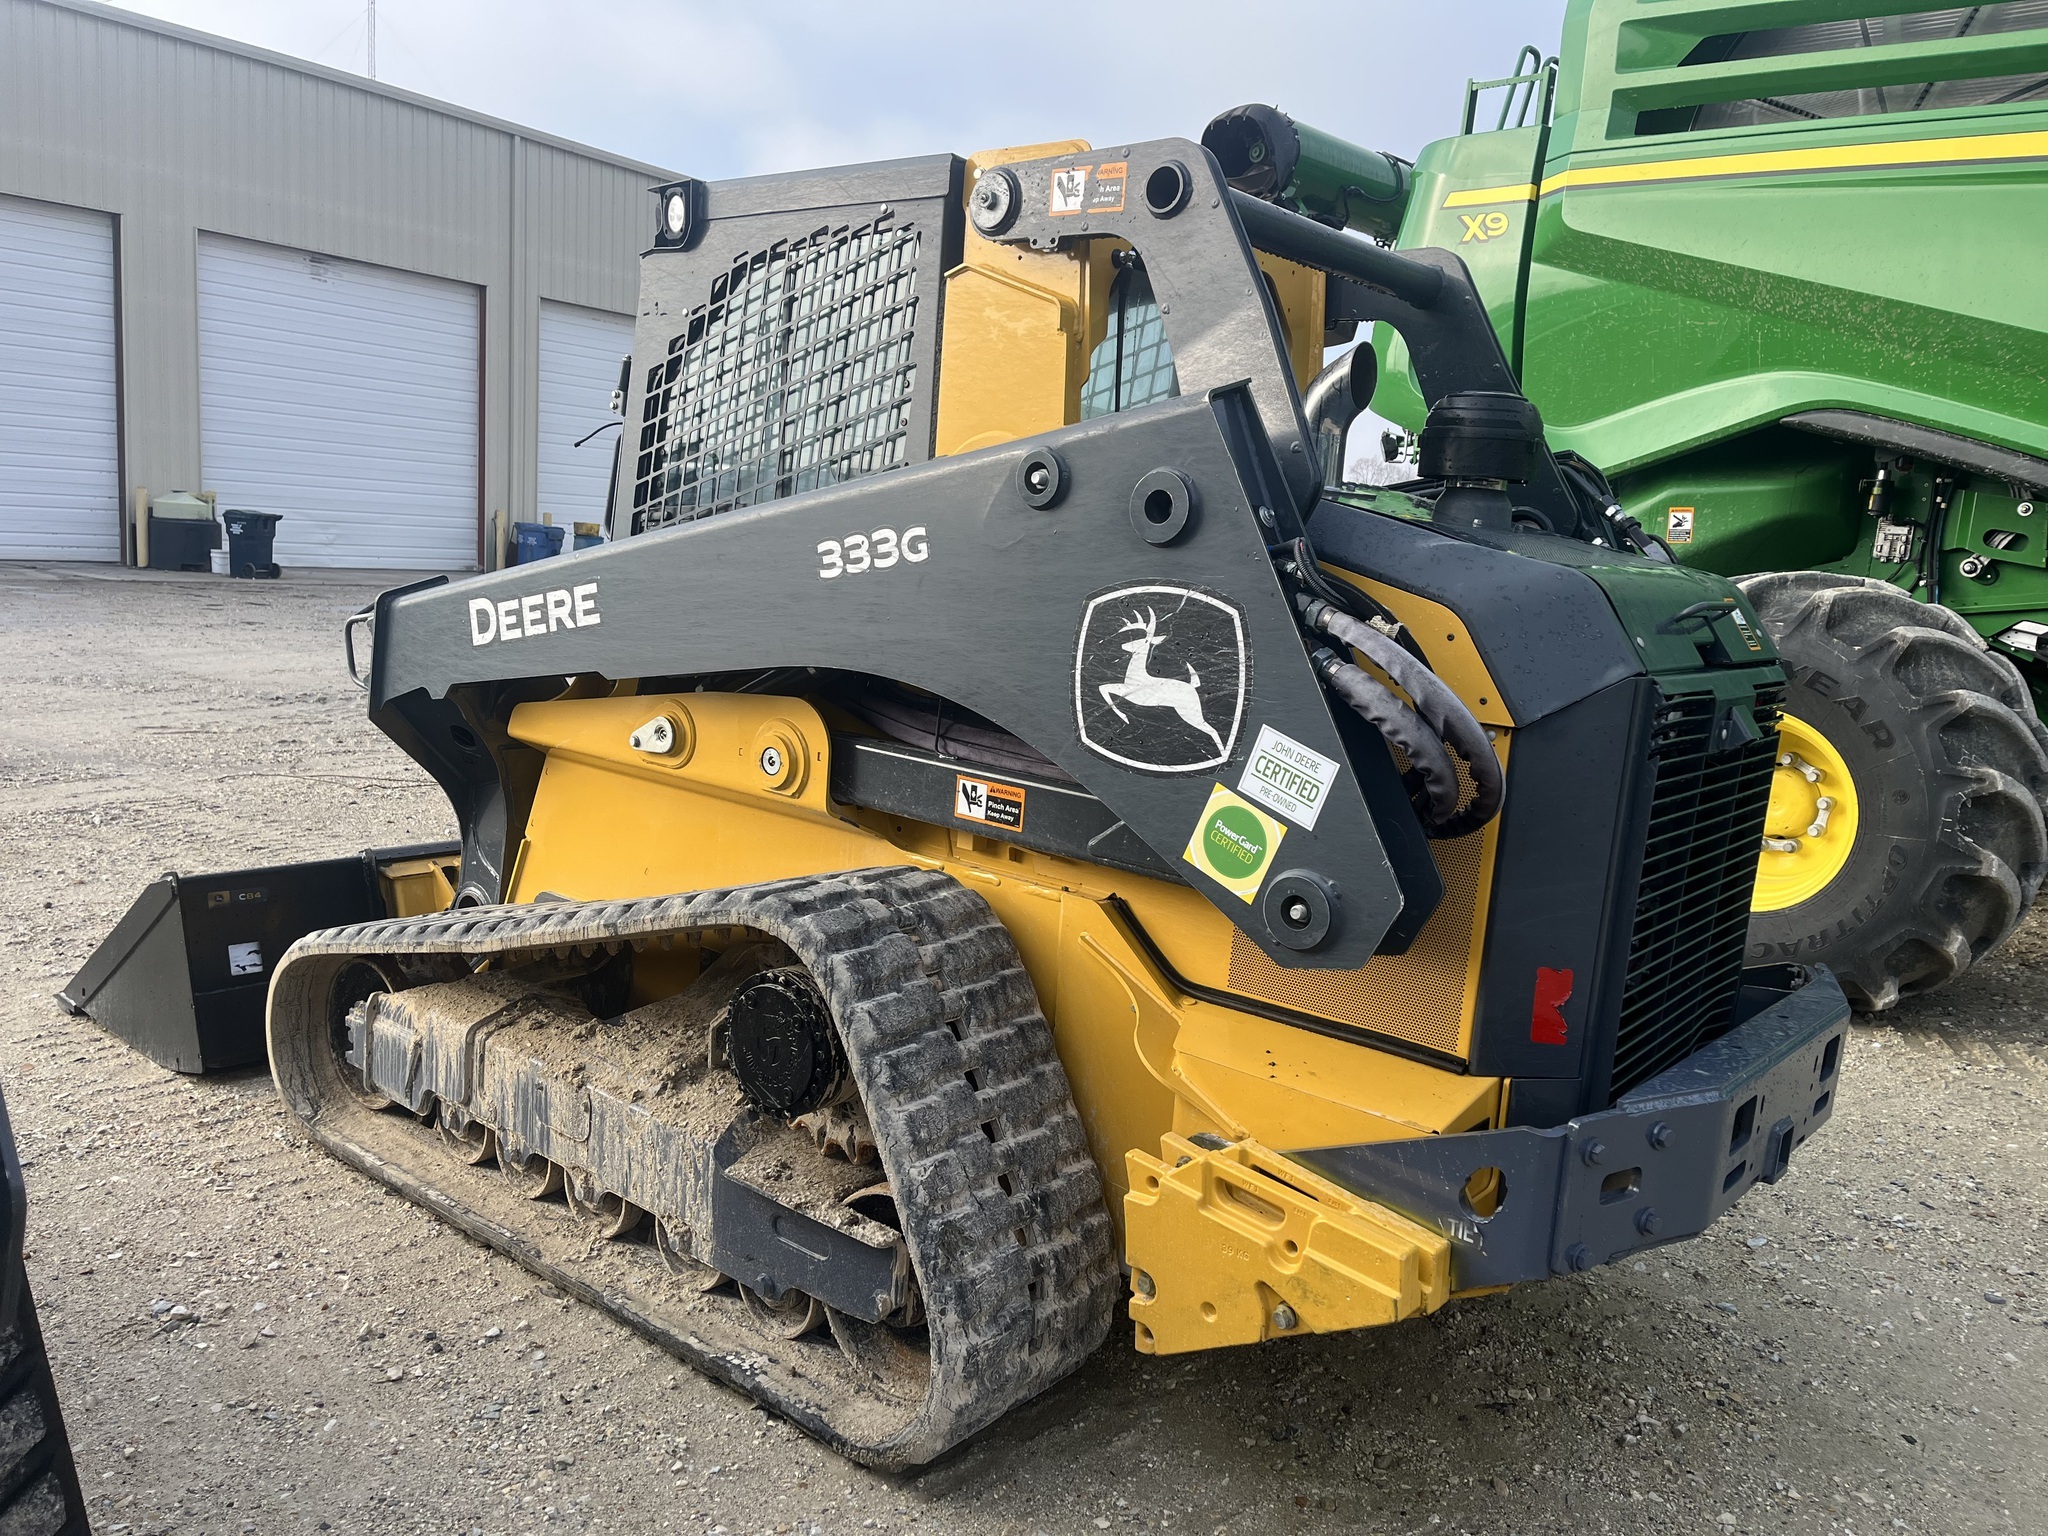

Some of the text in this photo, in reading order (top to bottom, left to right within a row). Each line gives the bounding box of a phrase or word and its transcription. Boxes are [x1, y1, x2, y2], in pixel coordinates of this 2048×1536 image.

[1100, 195, 1115, 203] Away
[1104, 184, 1120, 192] Area
[1458, 211, 1509, 244] X9
[817, 527, 929, 579] 333G
[469, 582, 600, 646] DEERE
[1271, 740, 1321, 774] JOHN DEERE
[995, 786, 1022, 799] WARNING
[1254, 755, 1320, 803] CERTIFIED
[987, 800, 1019, 814] Pinch Area
[1260, 785, 1297, 813] PRE-OWNED
[987, 810, 1014, 822] Keep Away
[1210, 829, 1254, 865] CERTIFIED
[239, 891, 262, 901] C84
